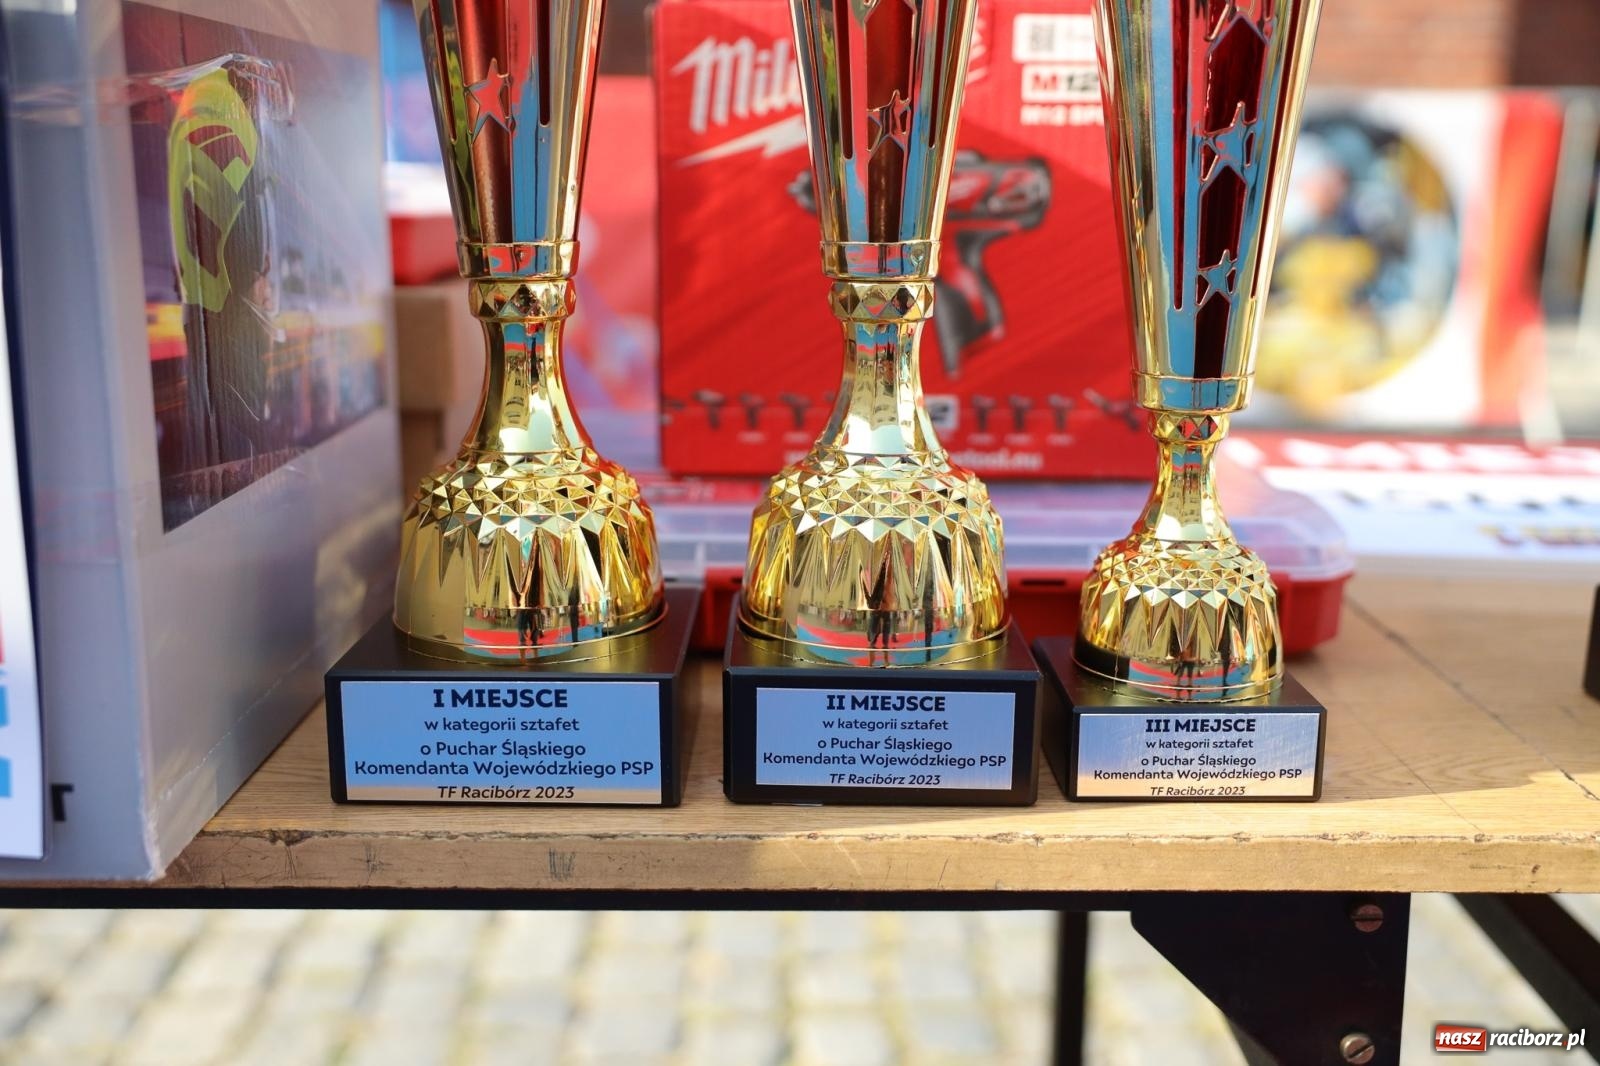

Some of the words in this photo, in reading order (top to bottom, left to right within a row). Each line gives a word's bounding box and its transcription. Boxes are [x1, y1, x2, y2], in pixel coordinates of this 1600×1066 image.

[433, 689, 445, 709] I
[451, 689, 568, 709] MIEJSCE
[826, 695, 846, 711] II
[851, 696, 946, 712] MIEJSCE
[424, 720, 439, 731] w
[443, 717, 516, 734] kategorii
[520, 717, 580, 731] sztafet
[822, 720, 835, 729] w
[838, 717, 897, 732] kategorii
[900, 719, 949, 731] sztafet
[1145, 719, 1171, 733] III
[1175, 718, 1257, 733] MIEJSCE
[420, 744, 431, 755] o
[436, 741, 497, 756] Puchar
[502, 738, 586, 759] Śląskiego
[817, 739, 827, 749] o
[831, 737, 881, 750] Puchar
[884, 736, 953, 753] Śląskiego
[1145, 740, 1157, 749] w
[1159, 738, 1210, 751] kategorii
[1212, 738, 1254, 749] sztafet
[763, 752, 857, 765] Komendanta
[860, 753, 976, 769] Wojewódzkiego
[980, 755, 1007, 767] PSP
[1141, 757, 1149, 766] o
[1152, 755, 1195, 766] Puchar
[1198, 753, 1257, 768] Śląskiego
[355, 760, 469, 775] Komendanta
[473, 760, 616, 778] Wojewódzkiego
[621, 761, 654, 775] PSP
[1094, 768, 1174, 780] Komendanta
[1177, 768, 1276, 782] Wojewódzkiego
[1279, 768, 1302, 779] PSP
[829, 773, 846, 785] TF
[848, 773, 905, 785] Racibórz
[908, 774, 942, 786] 2023
[438, 786, 457, 799] TF
[461, 785, 531, 799] Racibórz
[534, 786, 575, 799] 2023
[1150, 786, 1164, 796] TF
[1166, 786, 1215, 797] Racibórz
[1217, 786, 1246, 796] 2023
